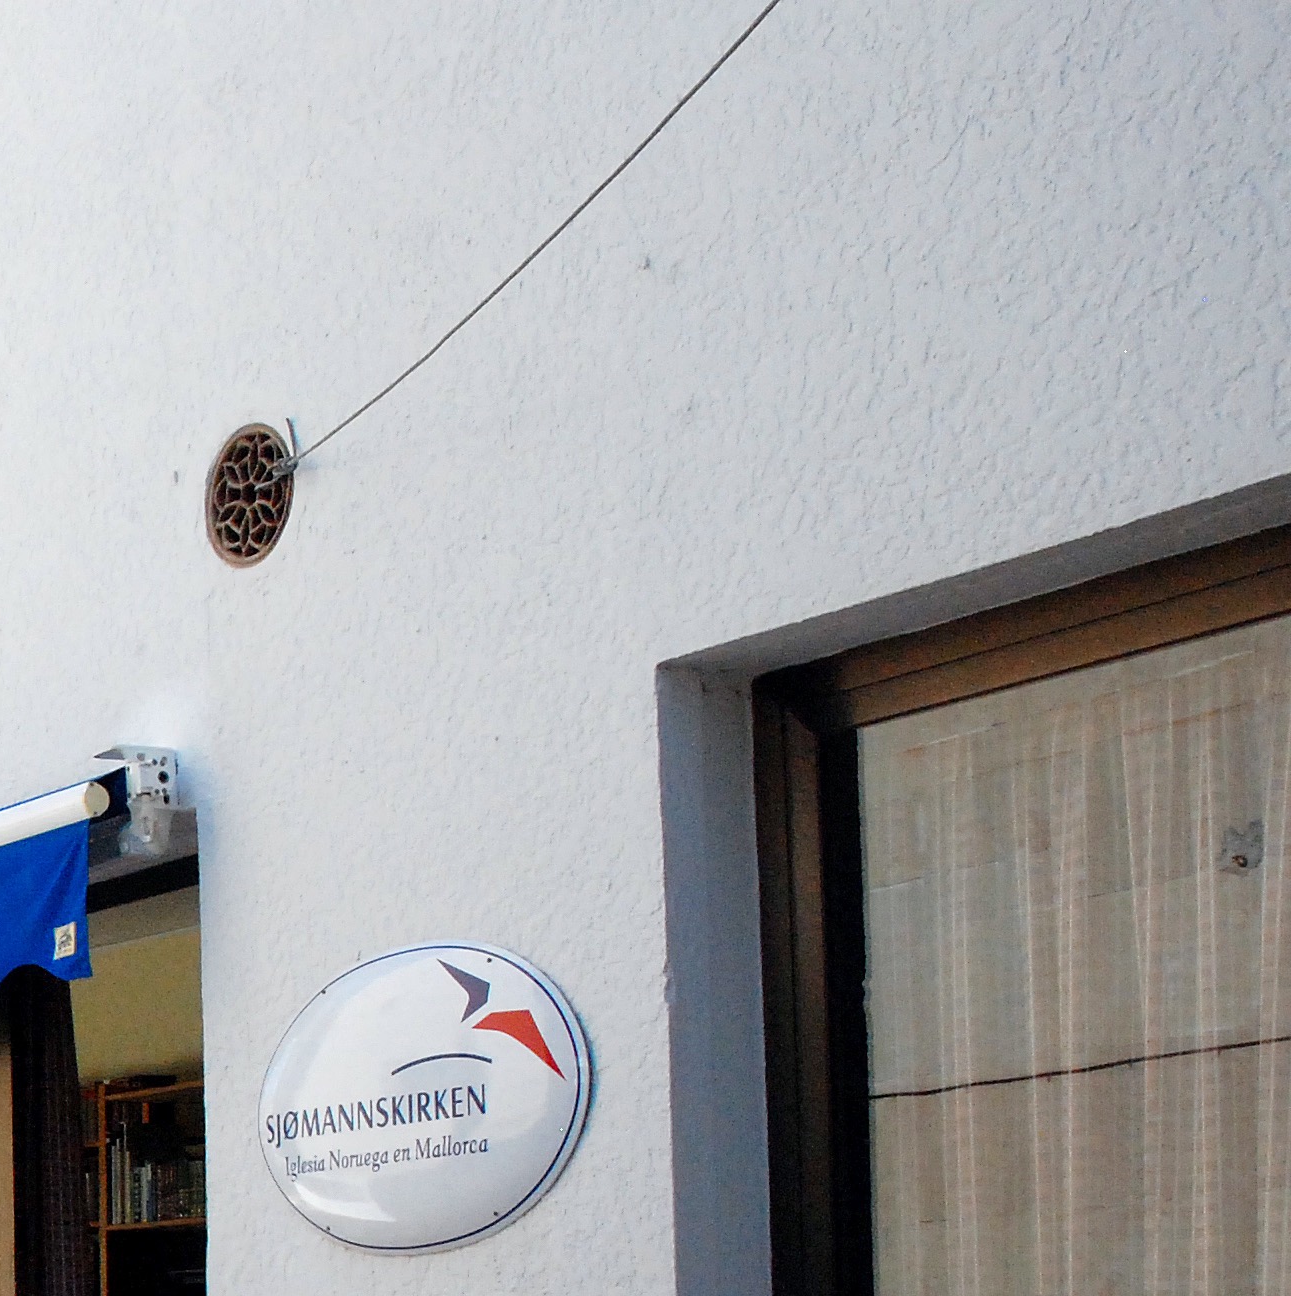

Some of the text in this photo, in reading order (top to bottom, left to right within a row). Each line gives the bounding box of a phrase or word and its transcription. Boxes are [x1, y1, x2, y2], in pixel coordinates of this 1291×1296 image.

[266, 1083, 488, 1149] SJØMANNSKIRKEN
[284, 1135, 489, 1182] Iglesia Noruega en Mallorca
